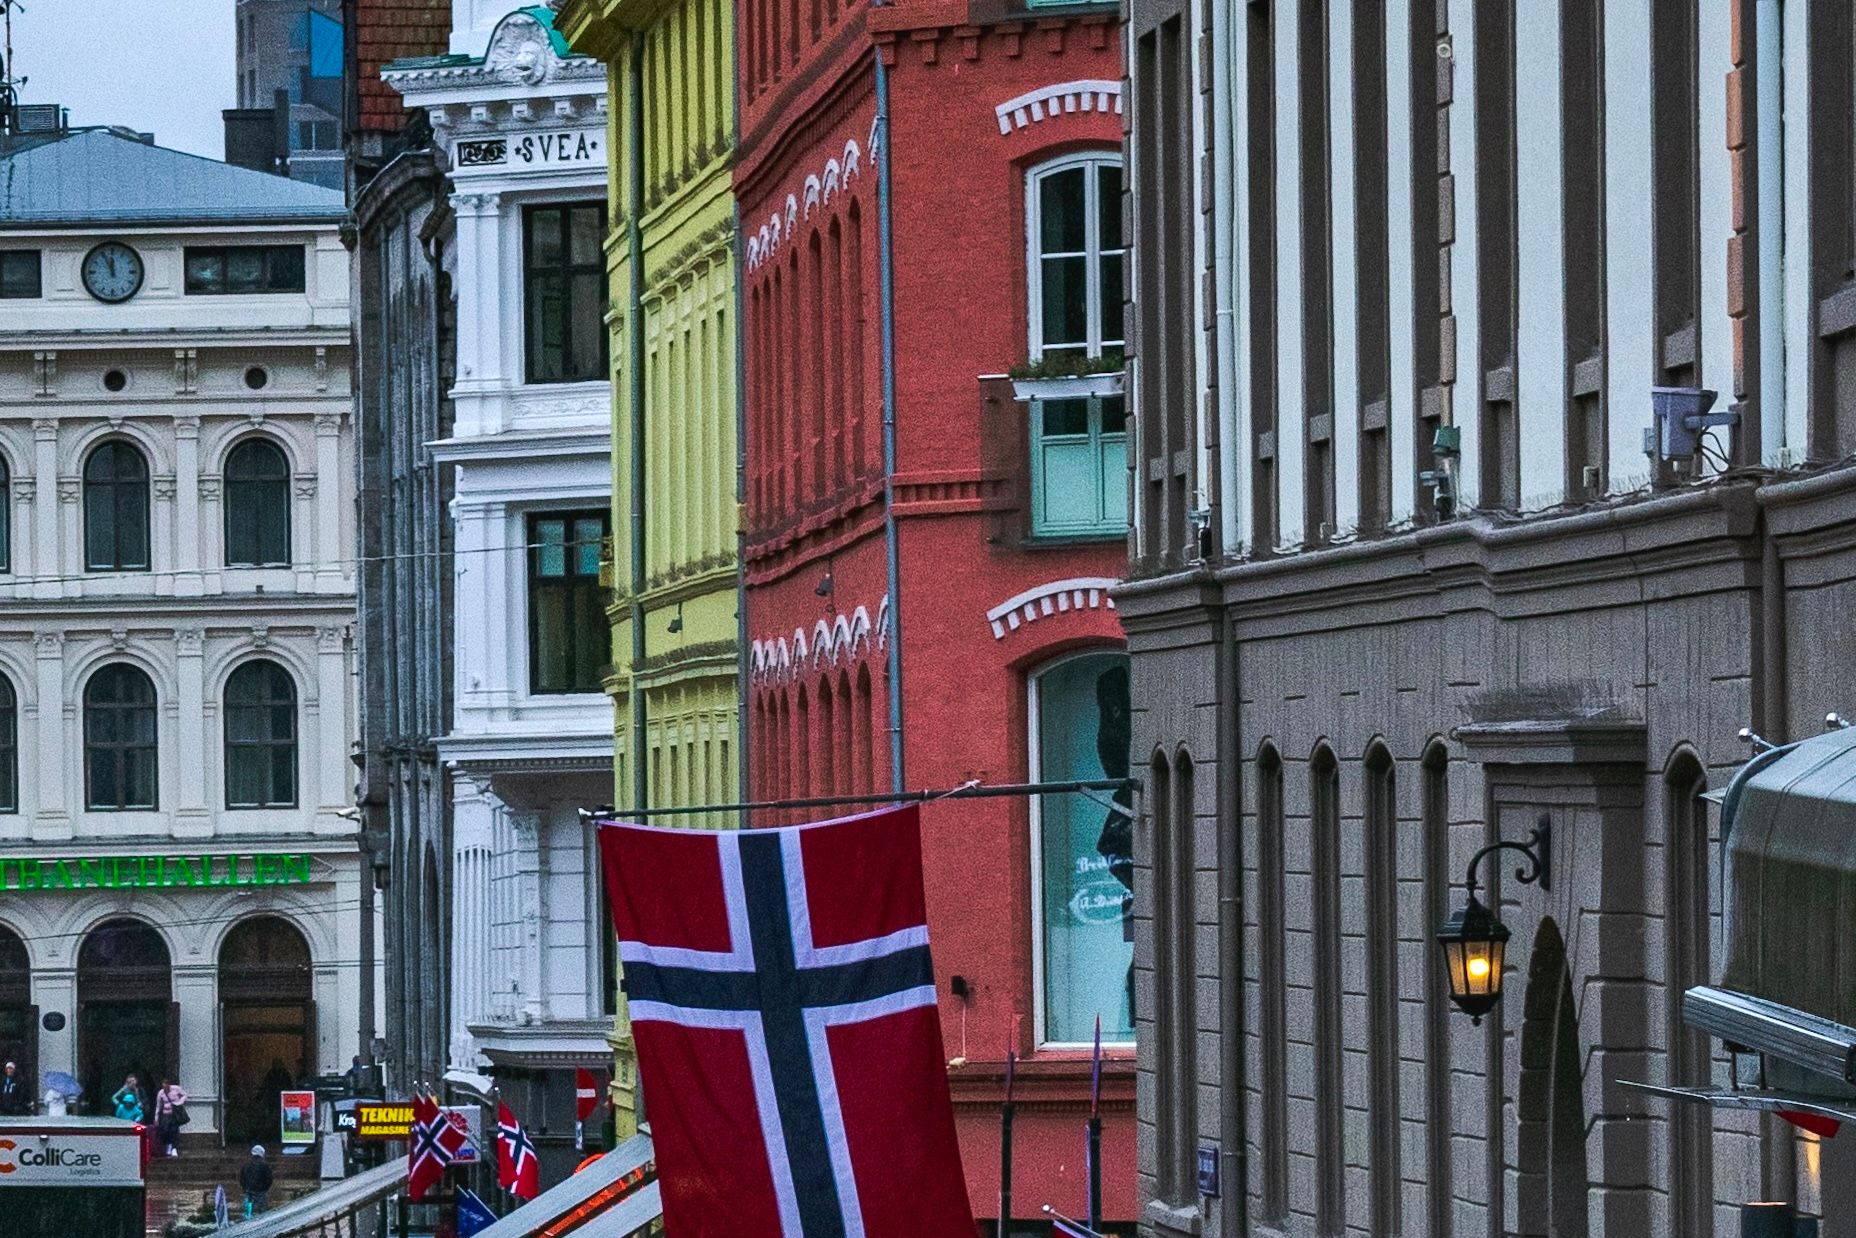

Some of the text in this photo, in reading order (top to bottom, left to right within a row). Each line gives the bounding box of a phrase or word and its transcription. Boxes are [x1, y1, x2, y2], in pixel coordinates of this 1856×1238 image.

[522, 132, 590, 163] SVEA
[338, 1113, 357, 1129] Kro
[360, 1107, 415, 1123] TEKNIK
[360, 1126, 410, 1135] MAGASINE
[18, 1148, 101, 1167] ColliCare
